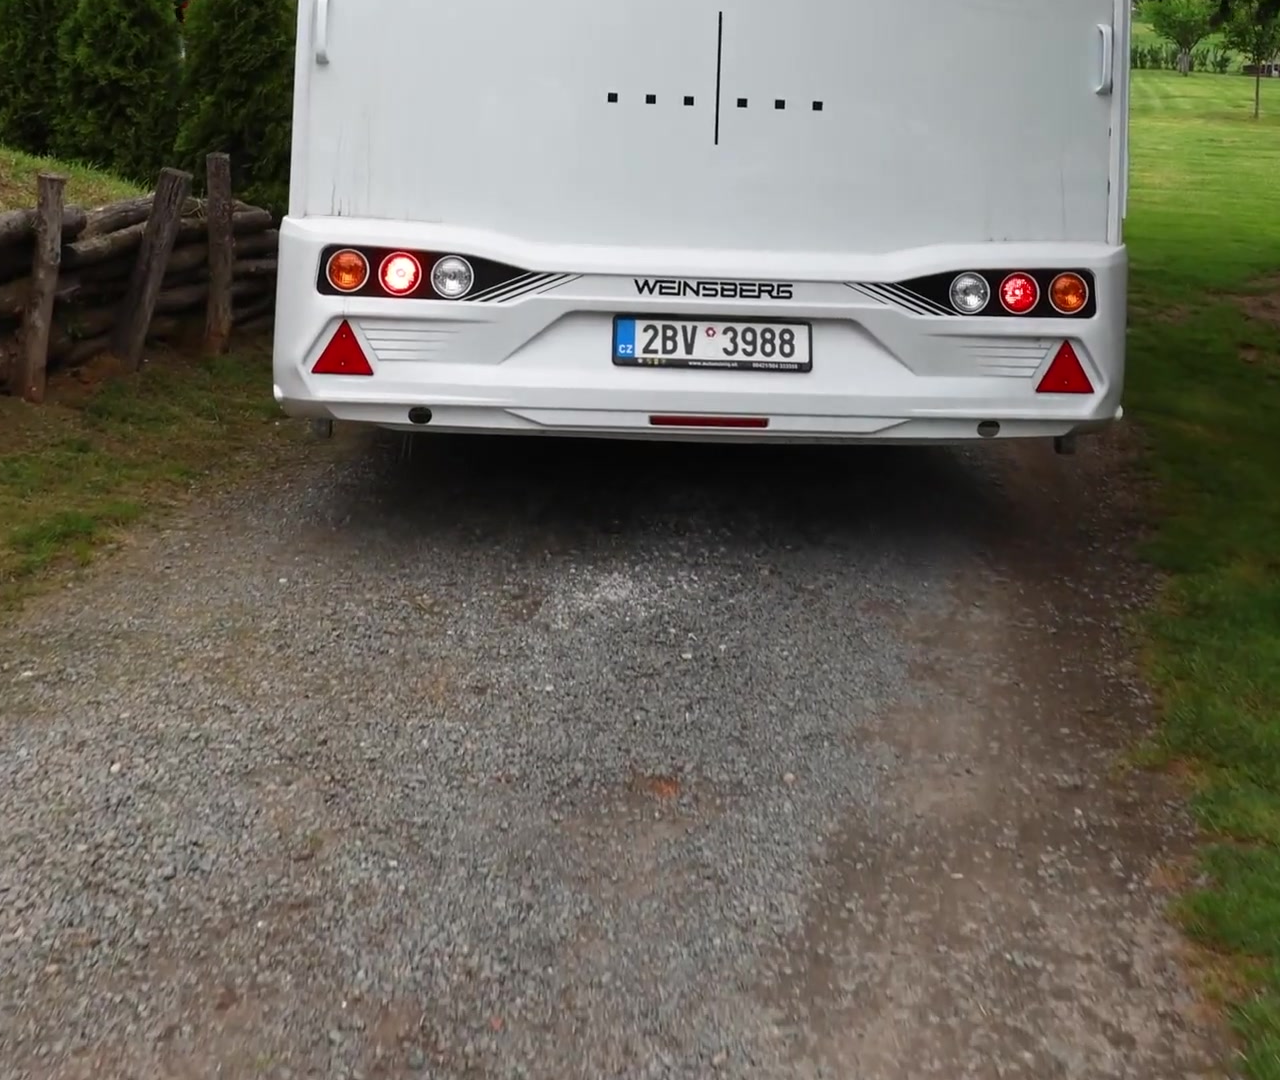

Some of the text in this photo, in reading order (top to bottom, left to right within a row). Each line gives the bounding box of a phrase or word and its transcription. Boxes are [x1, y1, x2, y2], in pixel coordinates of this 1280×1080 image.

[633, 278, 793, 300] WEINSBERG
[618, 345, 633, 354] CZ
[641, 323, 795, 358] 2BV 3988
